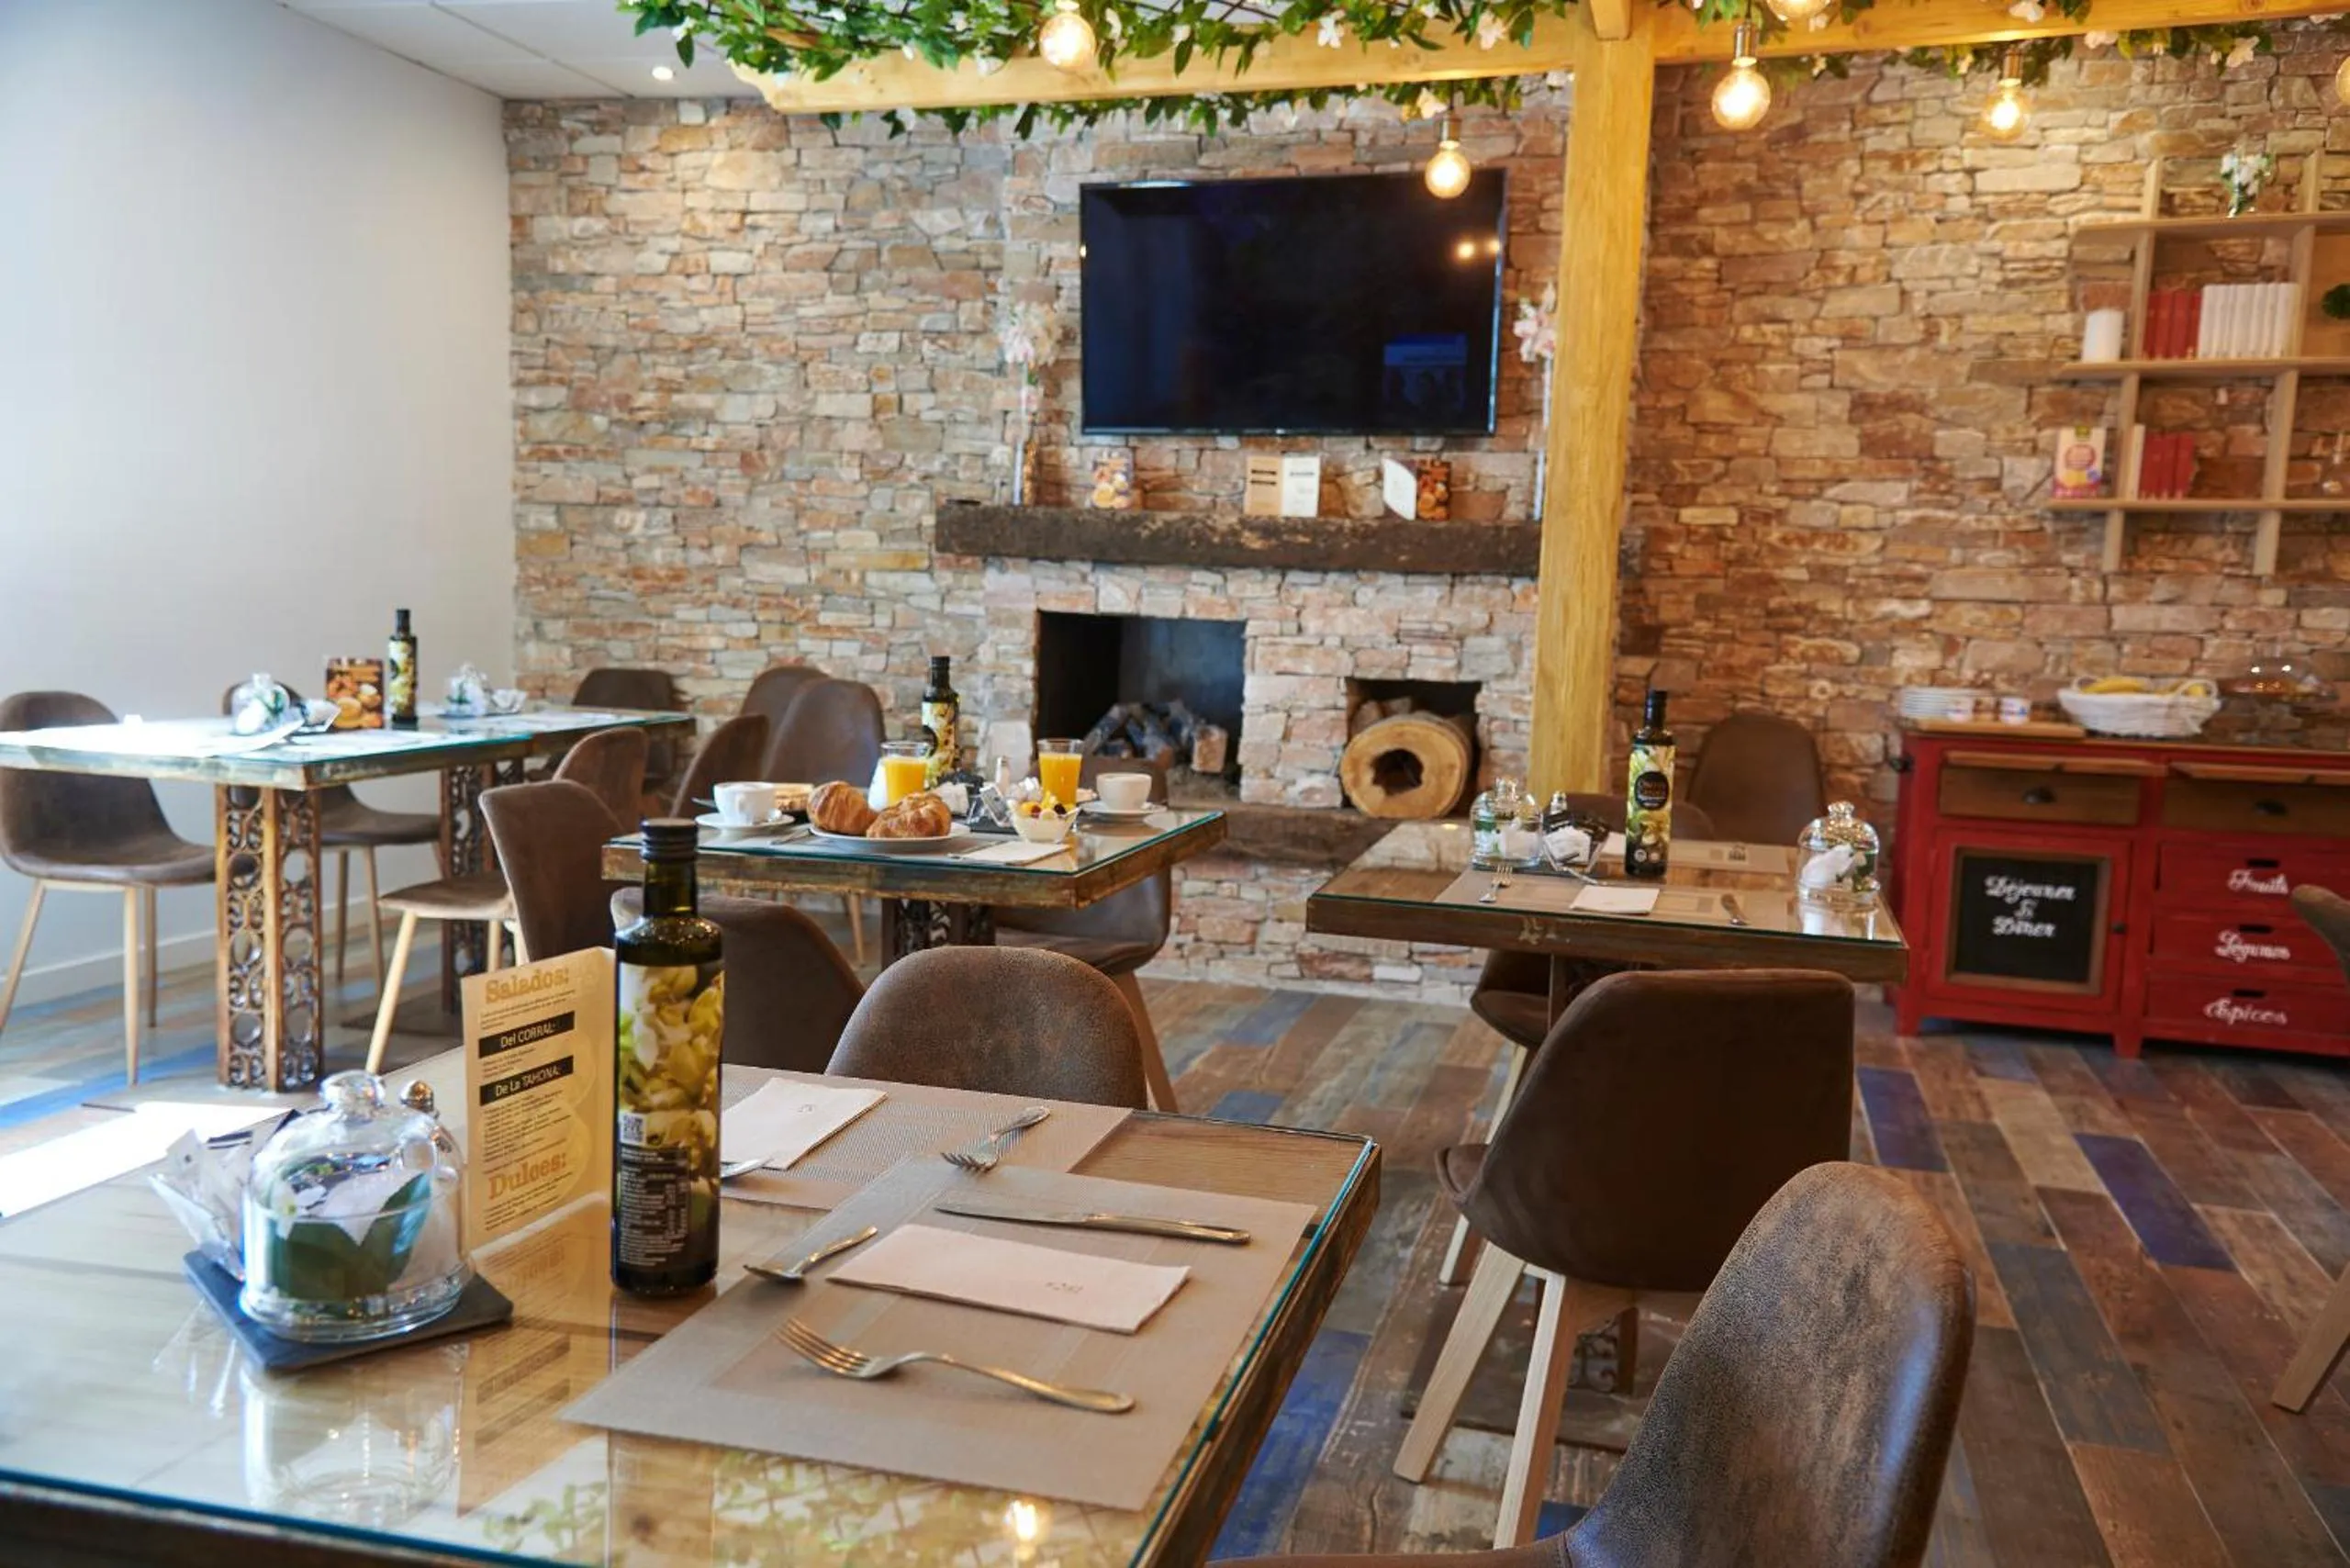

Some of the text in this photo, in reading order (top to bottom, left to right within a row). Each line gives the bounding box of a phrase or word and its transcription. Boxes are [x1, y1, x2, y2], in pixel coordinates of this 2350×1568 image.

[500, 1033, 517, 1048] Del
[496, 1083, 509, 1097] De
[509, 1078, 520, 1092] La
[488, 1151, 566, 1201] Dulces:
